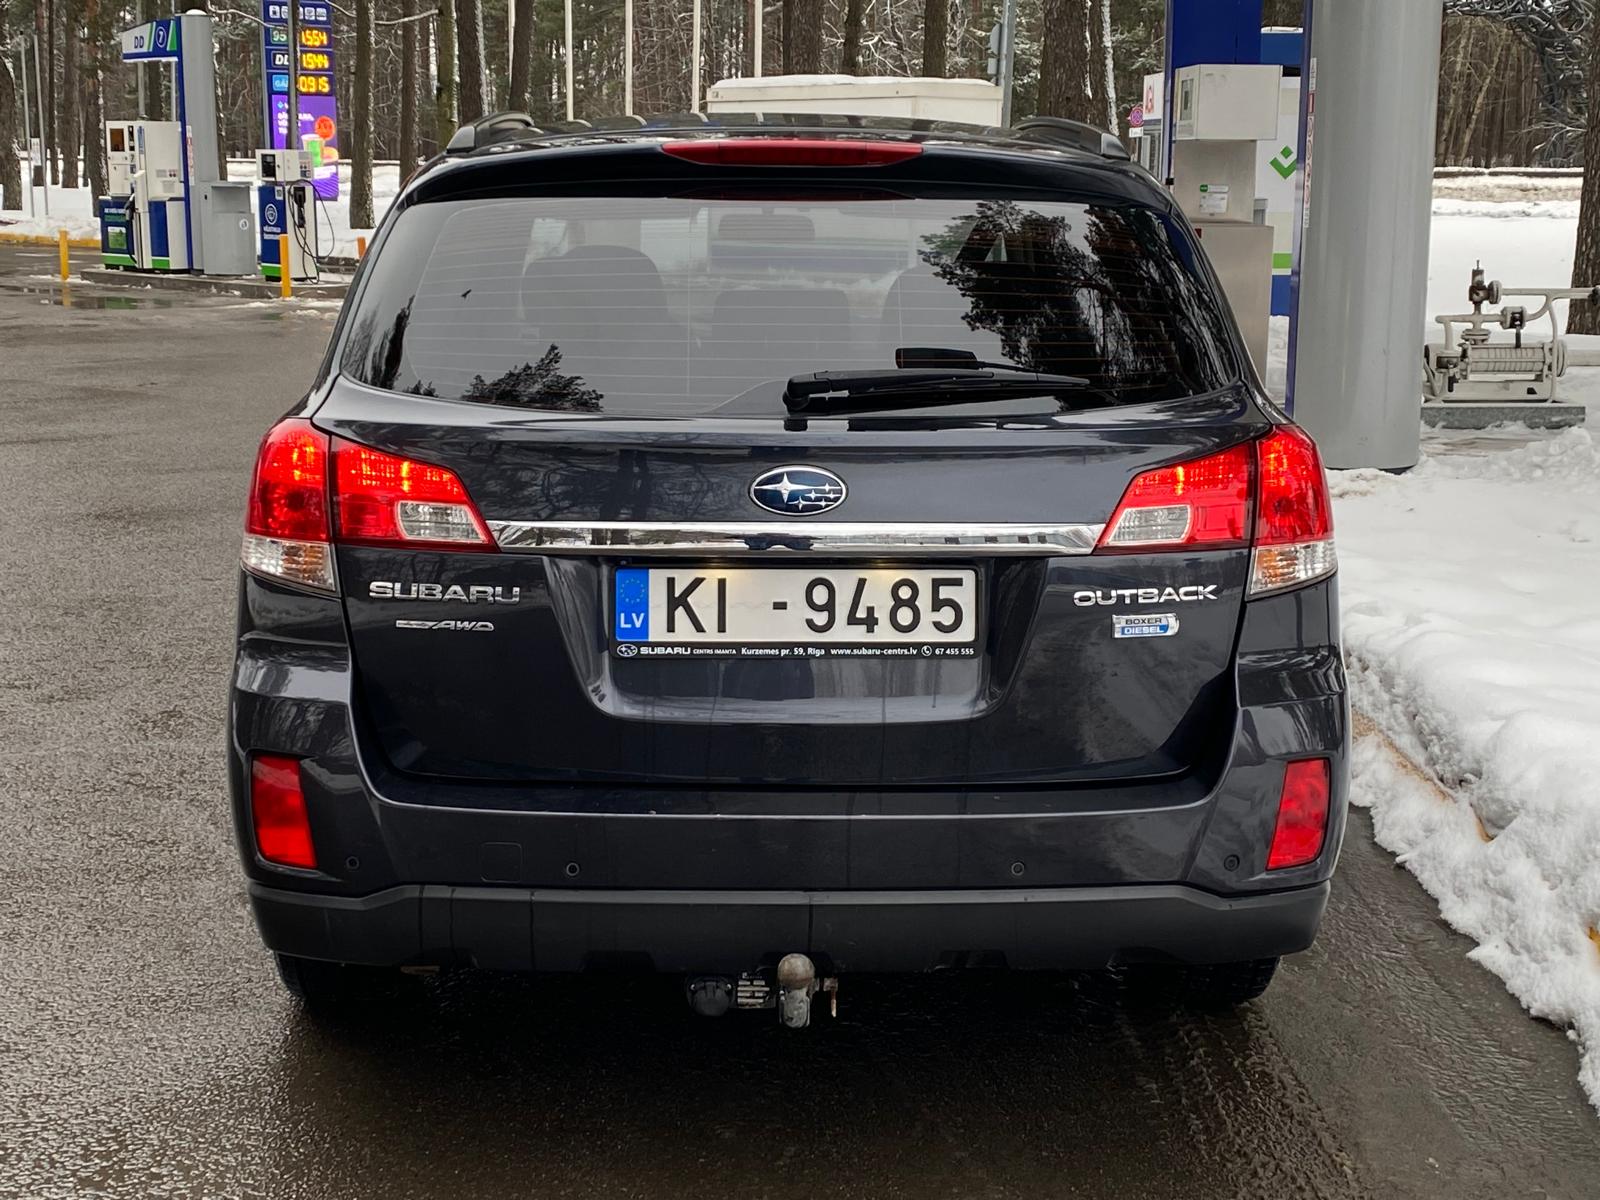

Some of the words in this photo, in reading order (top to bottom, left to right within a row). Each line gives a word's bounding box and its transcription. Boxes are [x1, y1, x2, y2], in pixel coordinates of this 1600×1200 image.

[134, 35, 145, 48] DD
[369, 581, 520, 604] SUBARU
[1073, 584, 1218, 607] OUTBACK
[666, 577, 727, 633] KI
[620, 613, 645, 628] LV
[1125, 617, 1162, 625] BOXER
[1124, 626, 1165, 634] DIESEL
[640, 646, 691, 655] SUBARU
[741, 647, 779, 656] Kurzemes
[780, 649, 792, 658] pr.
[793, 647, 806, 657] 59,
[830, 646, 918, 656] www.subaru-centrs.lv
[935, 647, 944, 656] 67
[945, 647, 960, 656] 455
[960, 647, 974, 656] 555
